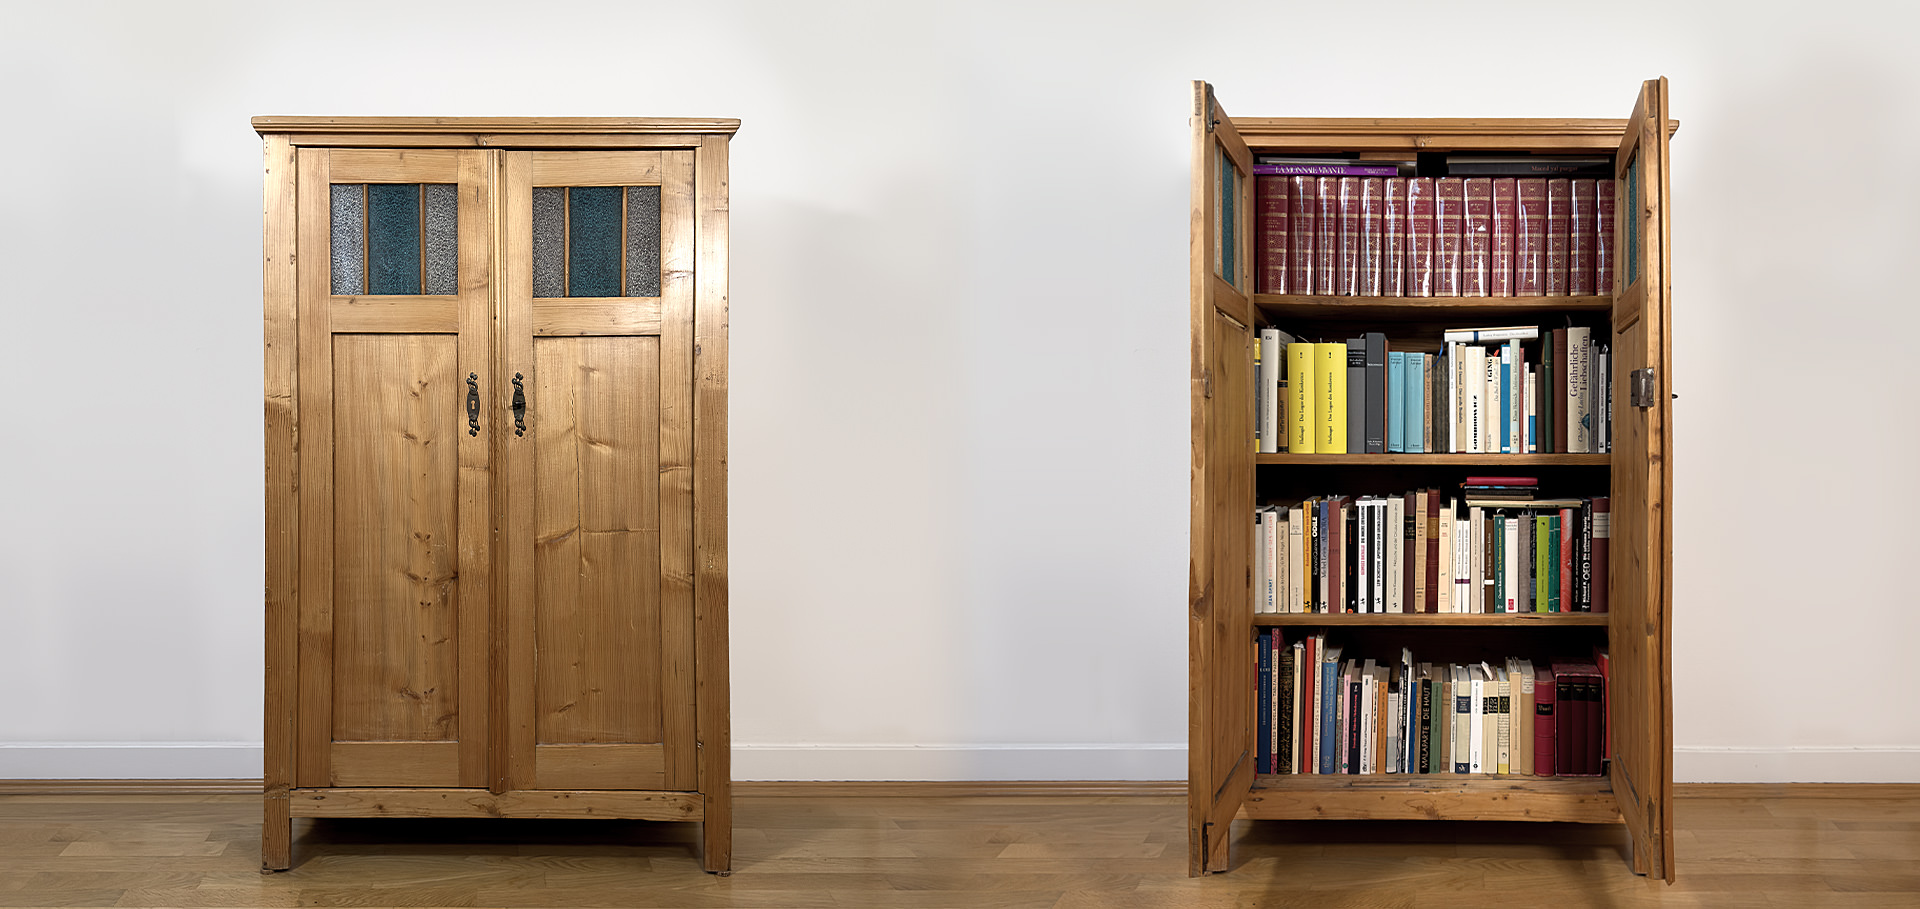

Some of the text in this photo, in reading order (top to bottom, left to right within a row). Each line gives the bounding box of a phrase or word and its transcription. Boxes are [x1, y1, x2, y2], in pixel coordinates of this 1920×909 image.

[1285, 166, 1317, 175] MONNAIE
[1317, 166, 1346, 174] VIVANTE
[1569, 344, 1579, 397] Gefährliche
[1580, 335, 1588, 391] Liebschaften
[1422, 686, 1430, 720] DIE HAUT
[1421, 725, 1430, 769] MALAPARTE
